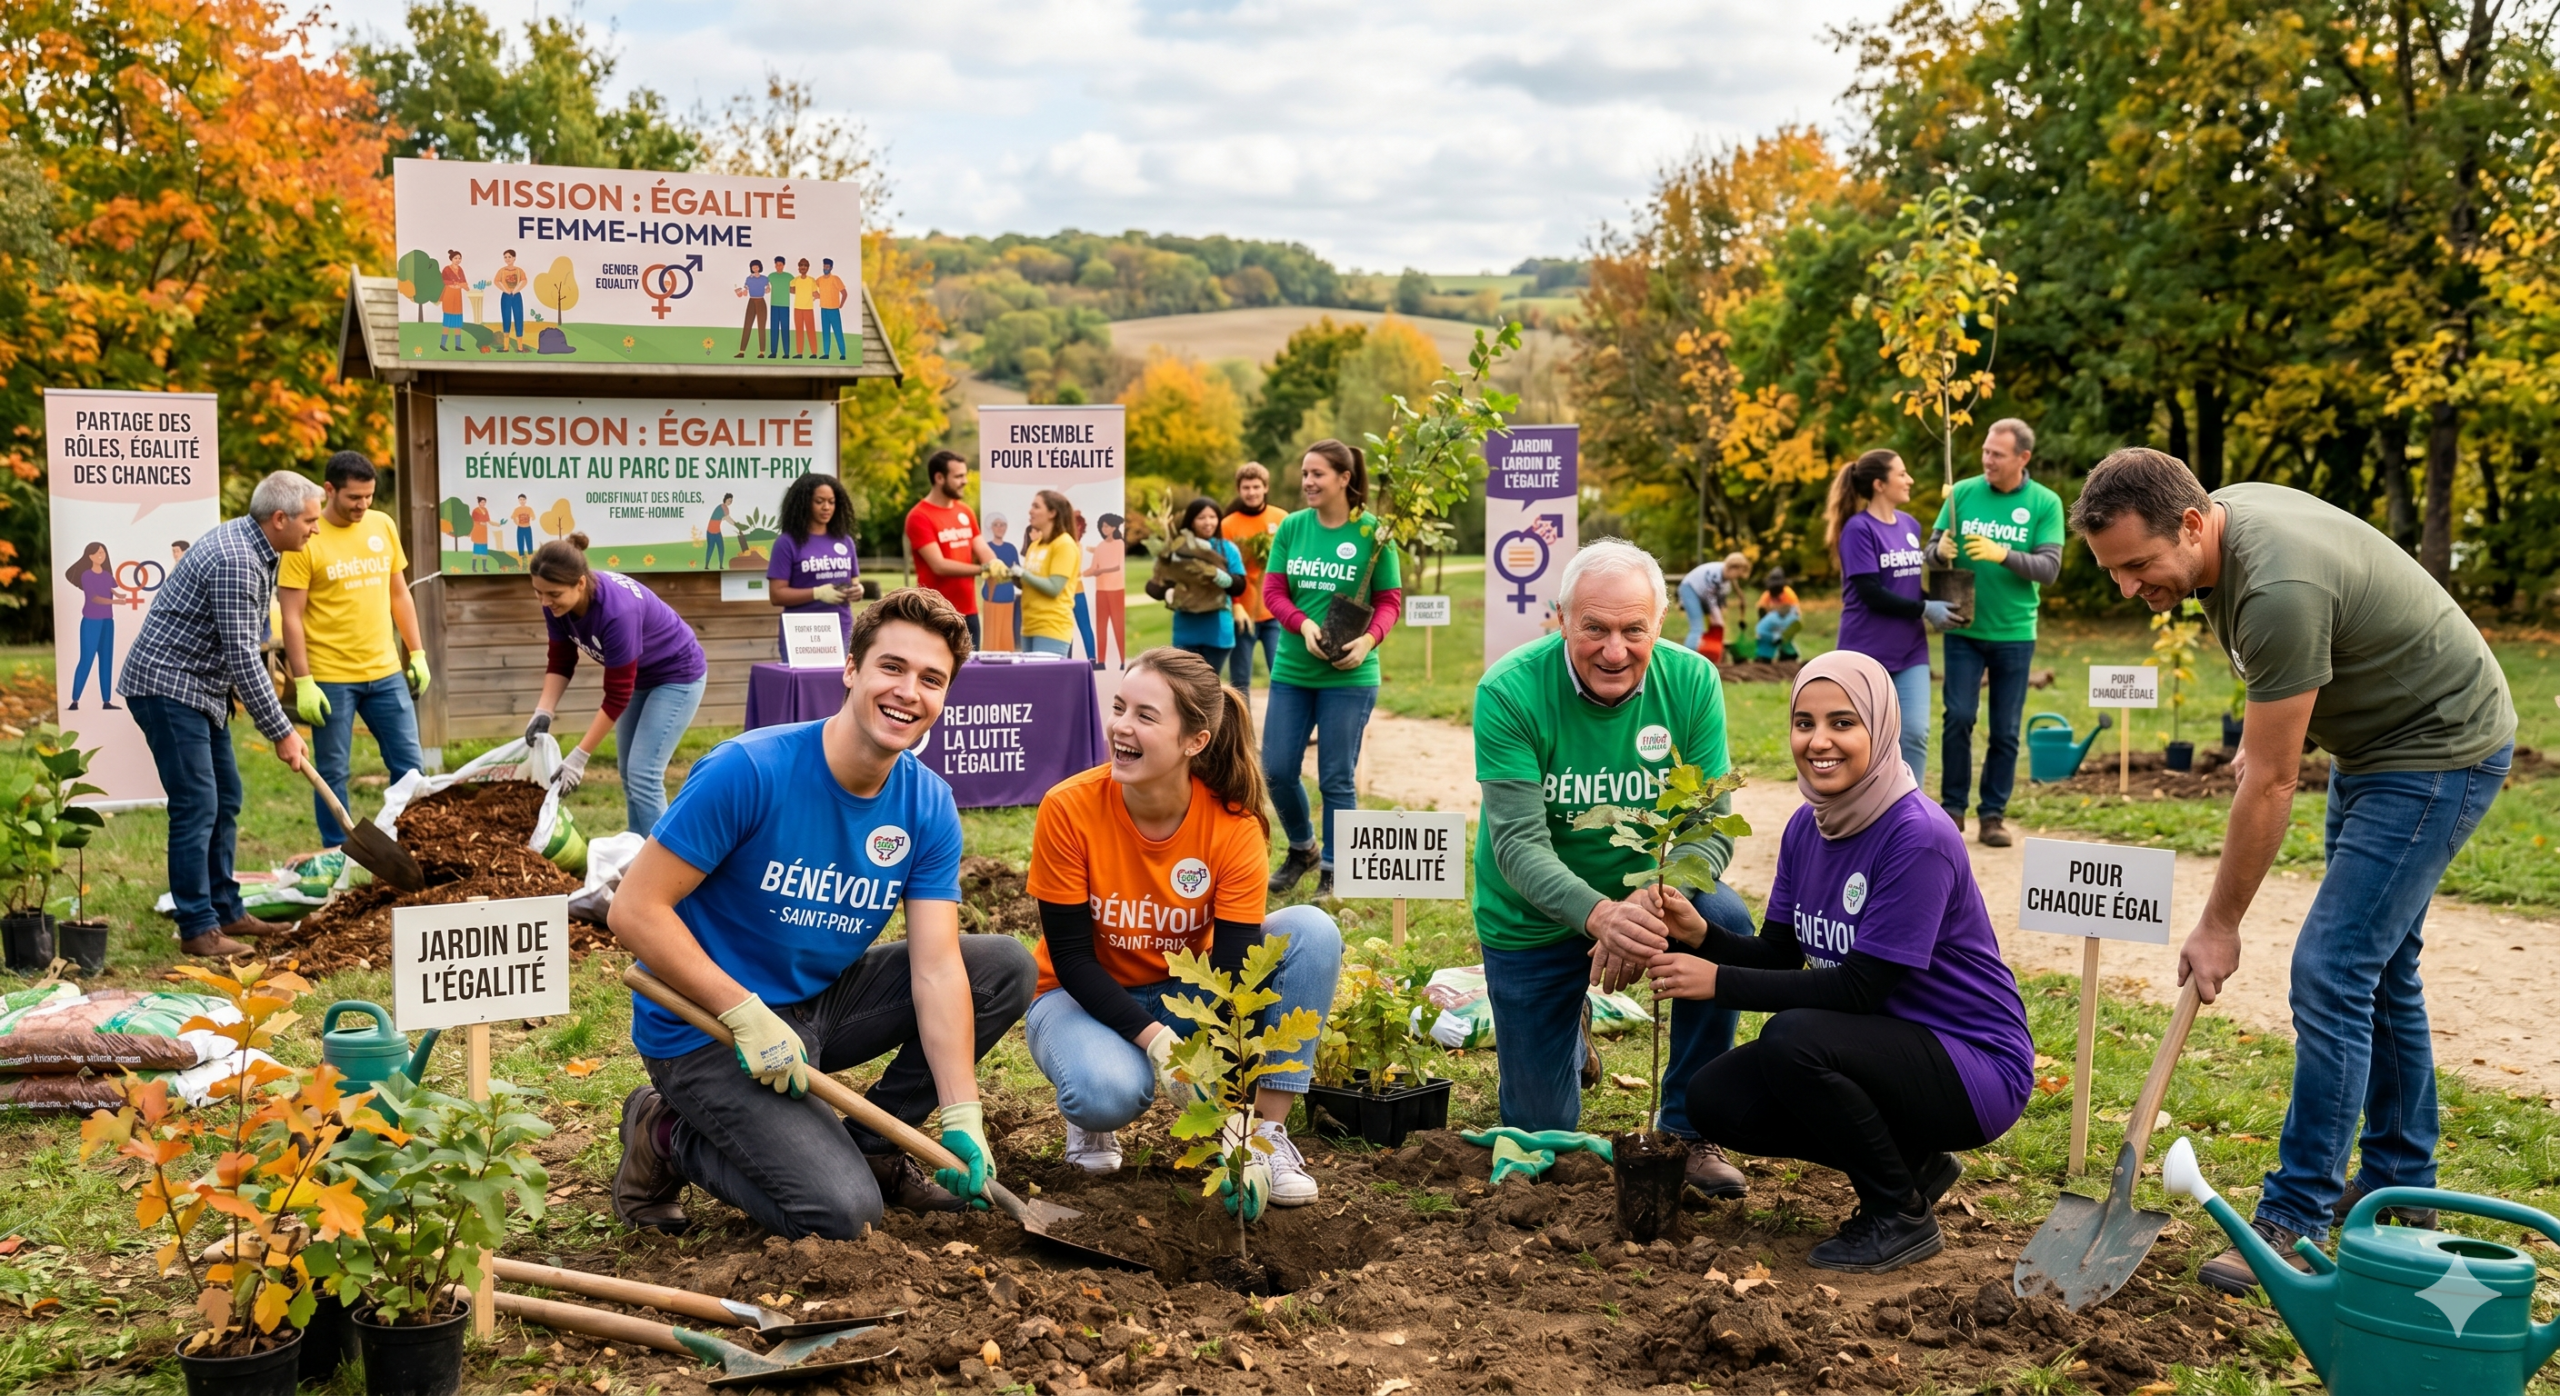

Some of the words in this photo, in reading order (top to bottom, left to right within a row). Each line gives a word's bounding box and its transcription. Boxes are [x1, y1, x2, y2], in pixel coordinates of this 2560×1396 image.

[470, 178, 623, 212] MISSION
[651, 177, 796, 220] ÉGALITÉ
[518, 216, 753, 247] FEMME-HOMME
[602, 263, 639, 276] GENDER
[595, 277, 640, 290] EQUALITY
[76, 411, 154, 432] PARTAGE
[159, 412, 191, 433] DES
[464, 415, 628, 446] MISSION
[658, 408, 813, 447] ÉGALITÉ
[1010, 424, 1094, 444] ENSEMBLE
[64, 433, 125, 461] RÔLES,
[130, 434, 200, 459] ÉGALITÉ
[990, 449, 1033, 469] POUR
[1038, 446, 1114, 469] L'ÉGALITÉ
[1510, 438, 1553, 454] JARDIN
[73, 464, 107, 485] DES
[112, 465, 191, 485] CHANCES
[465, 451, 582, 479] BÉNÉVOLAT
[587, 456, 613, 479] AU
[619, 456, 669, 479] PARC
[675, 456, 700, 479] DE
[705, 456, 813, 479] SAINT-PRIX
[1546, 455, 1563, 471] DE
[1504, 470, 1560, 489] L'ÉGALITÉ
[651, 491, 670, 504] DES
[672, 489, 705, 505] RÔLES,
[609, 506, 685, 519] FEMME-HOMME
[1961, 517, 2029, 543] BÉNÉVOLE
[325, 555, 391, 582] BÉNÉVOLE
[1286, 556, 1358, 582] BÉNÉVOLE
[2111, 673, 2135, 684] POUR
[2092, 687, 2127, 700] CHAQUE
[943, 729, 966, 751] LA
[969, 727, 1021, 750] LUTTE
[944, 746, 1026, 775] L'ÉGALITÉ
[1350, 826, 1418, 851] JARDIN
[1424, 828, 1448, 851] DE
[1352, 852, 1446, 882] L'ÉGALITÉ
[2069, 860, 2123, 888] POUR
[760, 857, 903, 911] BÉNÉVOLE
[2027, 887, 2107, 918] CHAQUE
[2112, 891, 2164, 924] ÉGAL
[779, 906, 865, 935] SAINT-PRIX
[418, 924, 508, 964] JARDIN
[517, 920, 549, 954] DE
[1108, 933, 1189, 951] SAINT-PRIX
[422, 955, 546, 1005] L'ÉGALITÉ
